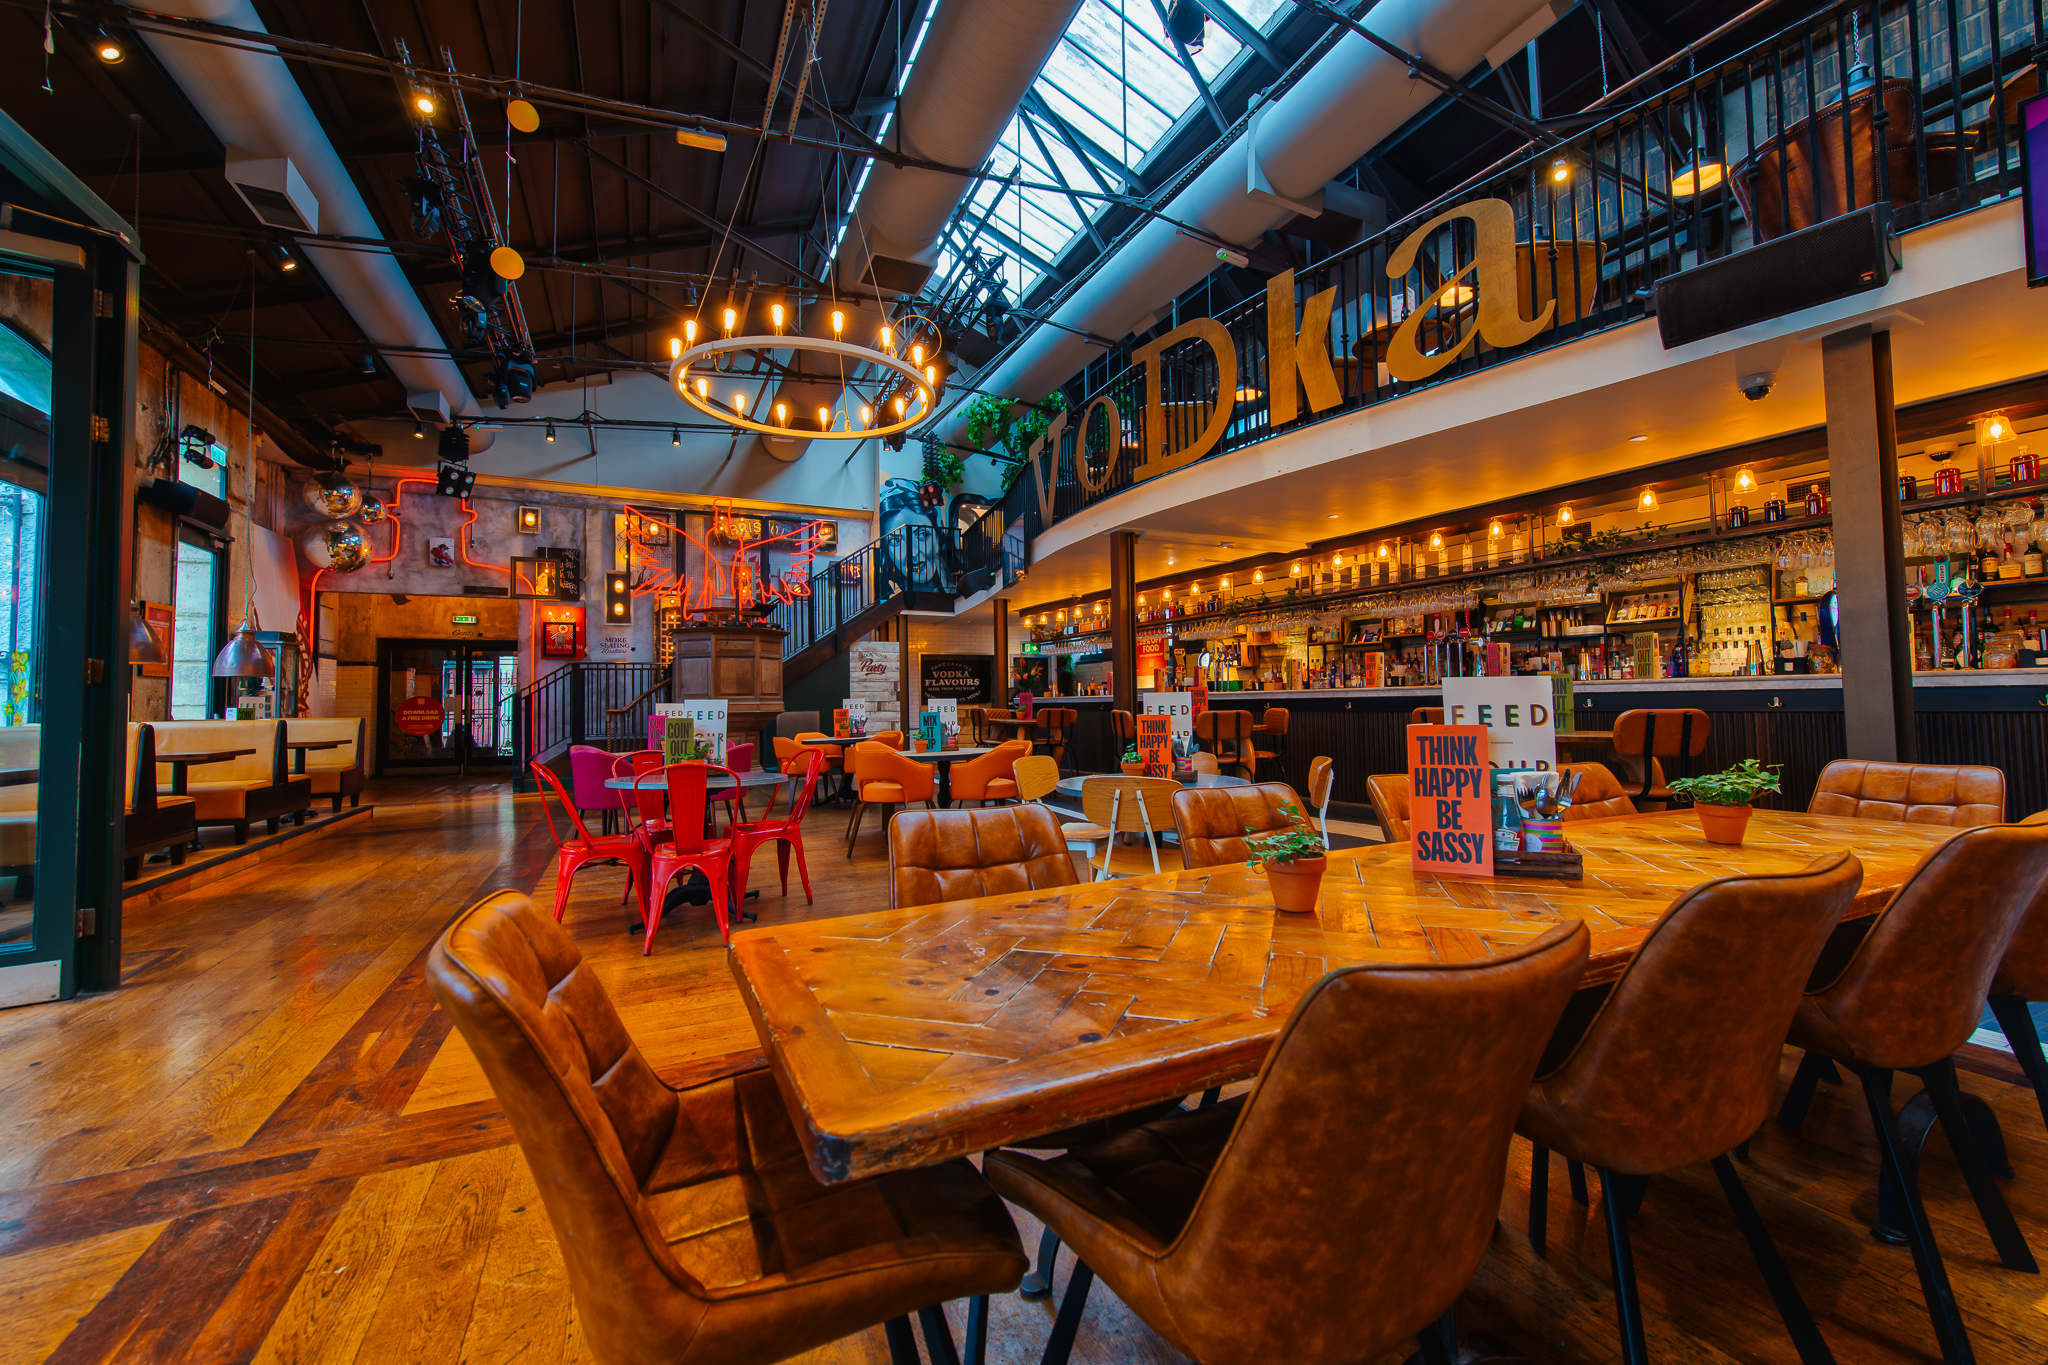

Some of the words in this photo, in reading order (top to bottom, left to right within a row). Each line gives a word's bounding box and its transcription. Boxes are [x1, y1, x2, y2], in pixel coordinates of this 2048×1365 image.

[452, 629, 475, 637] Gents
[1142, 644, 1160, 653] FOOD
[1637, 649, 1651, 663] OUT
[860, 658, 888, 676] Party
[931, 662, 972, 671] HANDCRAFTED
[1637, 663, 1651, 677] OUT
[932, 670, 970, 679] VODKA
[925, 678, 980, 687] FLAVOURS
[1192, 698, 1207, 706] APPY
[687, 710, 725, 721] FEED
[1146, 704, 1190, 716] FEED
[1451, 703, 1550, 728] FEED
[923, 715, 938, 727] MIX
[1141, 720, 1168, 734] THINK
[668, 722, 692, 739] GOIN'
[926, 727, 935, 737] IT
[670, 740, 690, 757] OUT
[1140, 734, 1169, 749] HAPPY
[1149, 749, 1160, 763] BE
[1416, 735, 1479, 766] THINK
[1414, 767, 1483, 798] HAPPY
[1436, 799, 1463, 831] BE
[1416, 830, 1485, 864] SASSY
